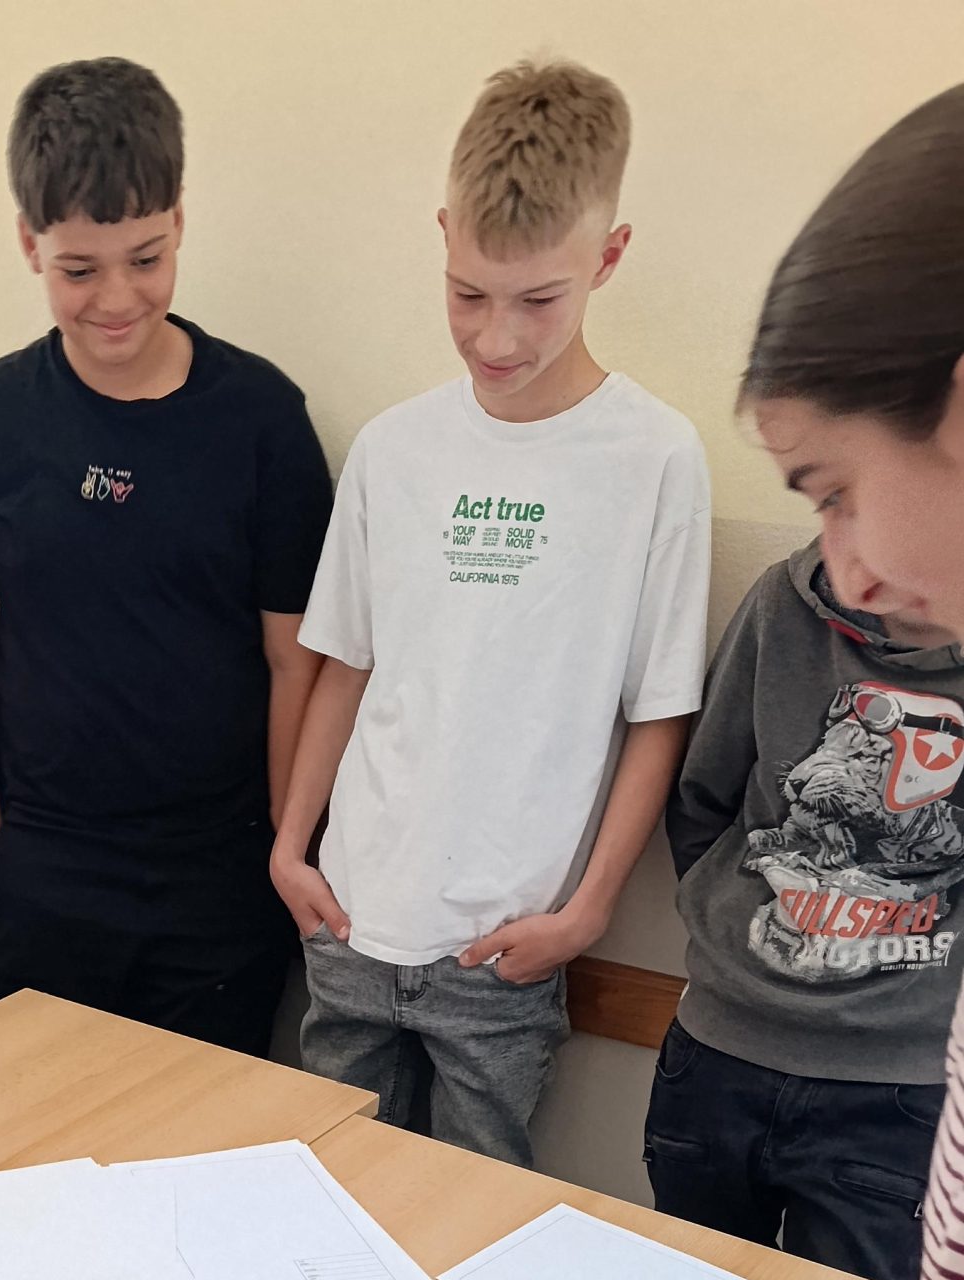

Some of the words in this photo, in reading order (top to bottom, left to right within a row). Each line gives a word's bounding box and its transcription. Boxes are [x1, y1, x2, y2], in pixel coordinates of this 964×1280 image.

[452, 494, 493, 520] Act
[497, 496, 545, 523] true
[452, 525, 476, 537] YOUR
[506, 527, 535, 540] SOLID
[452, 536, 472, 547] WAY
[505, 537, 534, 550] MOVE
[539, 535, 548, 545] 75
[449, 571, 500, 584] CALIFORNIA
[501, 574, 520, 586] 1975
